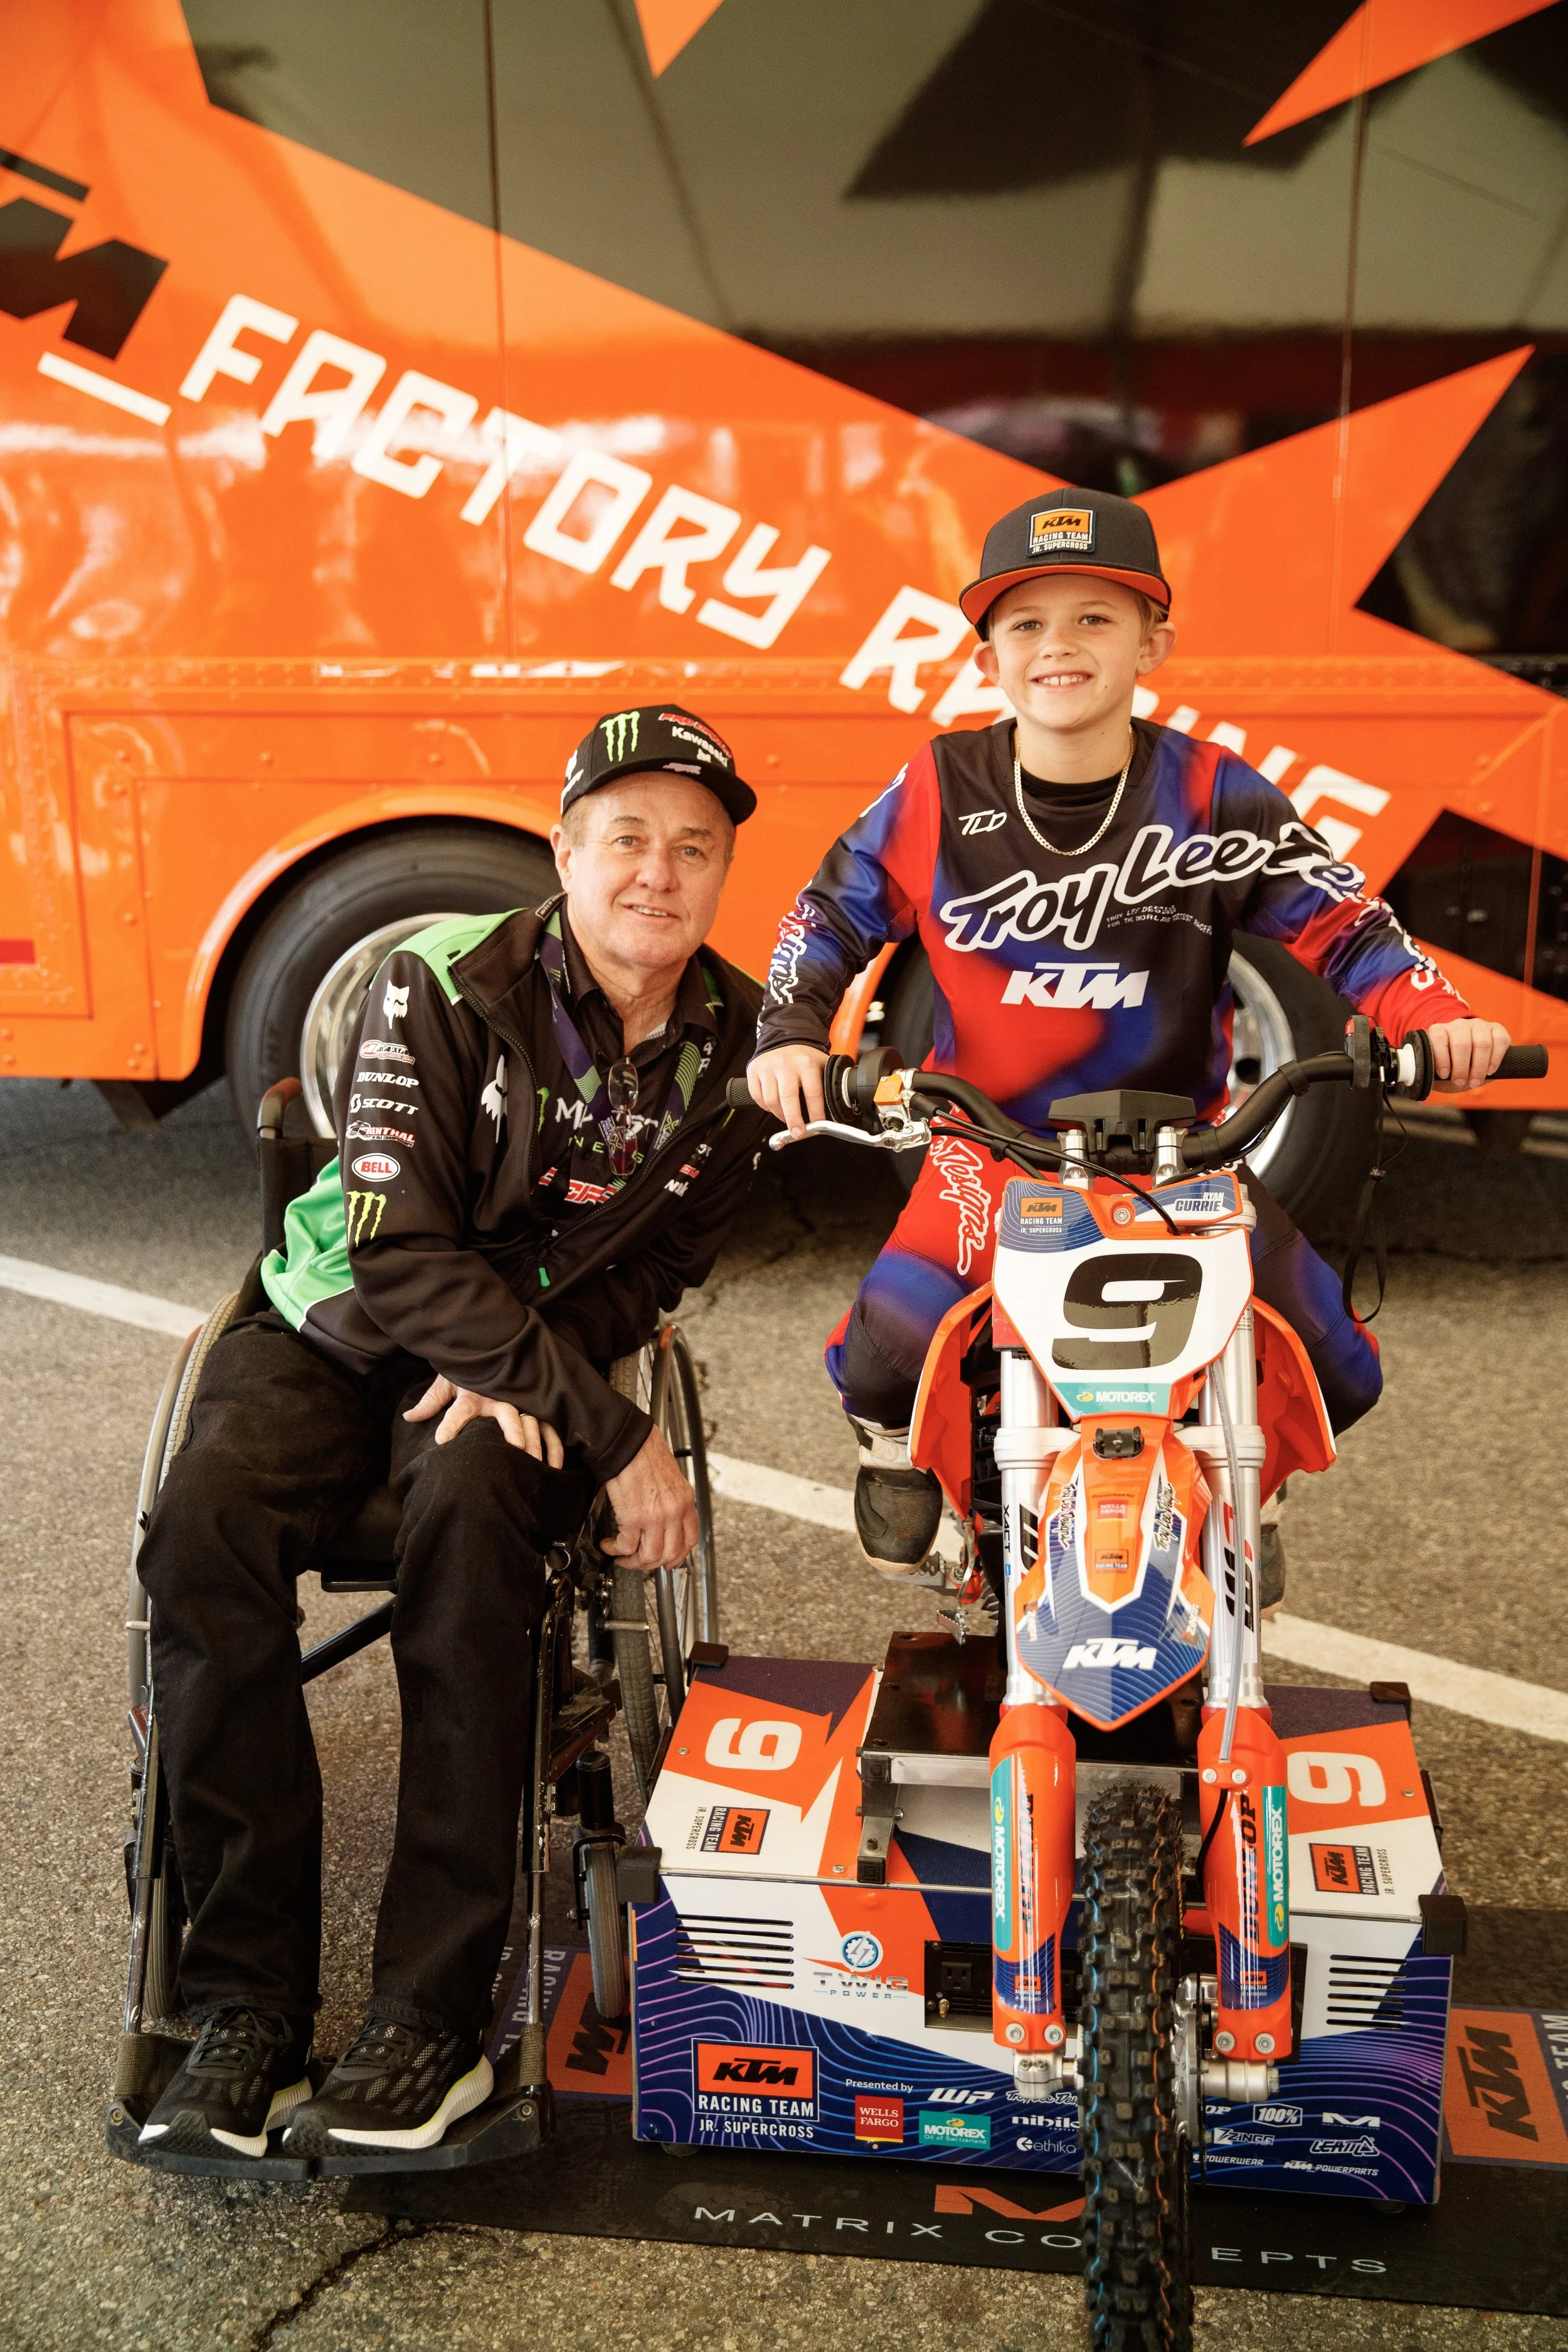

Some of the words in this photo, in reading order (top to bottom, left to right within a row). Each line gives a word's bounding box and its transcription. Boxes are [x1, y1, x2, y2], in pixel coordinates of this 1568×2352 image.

[1042, 516, 1081, 529] KTM
[1033, 532, 1064, 544] RACING
[1066, 532, 1089, 541] TEAM
[1044, 541, 1088, 551] SUPERCROSS
[940, 863, 1120, 952] Troy
[1113, 824, 1276, 904] Lee
[1106, 913, 1123, 923] TROY
[1107, 920, 1120, 928] FOR
[1000, 962, 1150, 1010] KTM
[356, 1072, 420, 1088] DUNLOP
[362, 1098, 419, 1115] SCOTT
[366, 1127, 415, 1143] RENTHAL
[361, 1162, 393, 1174] BELL
[1202, 1192, 1224, 1200] RYAN
[1026, 1202, 1057, 1212] KTM
[1175, 1200, 1222, 1212] CURRIE
[1020, 1217, 1044, 1226] RACING
[1051, 1253, 1203, 1370] 9
[1096, 1392, 1155, 1403] MOTOREX
[1062, 1638, 1158, 1671] KTM
[710, 1806, 727, 1833] RACING
[686, 1815, 704, 1850] SUPERCROSS
[729, 1814, 755, 1849] KTM
[701, 1832, 719, 1852] TEAM
[1272, 1806, 1285, 1902] MOTOREX
[1355, 1846, 1372, 1863] TEAM
[995, 1826, 1005, 1919] MOTOREX
[1326, 1851, 1348, 1885] KTM
[1377, 1848, 1393, 1883] SUPERCROSS
[1360, 1864, 1377, 1895] RACING
[813, 1971, 909, 1991] TWIG
[830, 1989, 892, 1999] POWER
[712, 2058, 799, 2086] KTM
[845, 2079, 899, 2090] Presented
[901, 2082, 914, 2093] by
[1457, 2026, 1539, 2143] KTM
[697, 2094, 763, 2114] RACING
[769, 2099, 815, 2117] TEAM
[859, 2107, 899, 2117] WELLS
[860, 2117, 899, 2127] FARGO
[1258, 2106, 1298, 2125] 100%
[699, 2119, 719, 2134] JR.
[723, 2120, 815, 2139] SUPERCROSS
[924, 2124, 985, 2139] MOTOREX
[945, 2136, 987, 2144] Switzerland
[1033, 2139, 1077, 2154] ethika
[694, 2206, 945, 2239] MATRIX
[985, 2230, 1389, 2274] COEPTS
